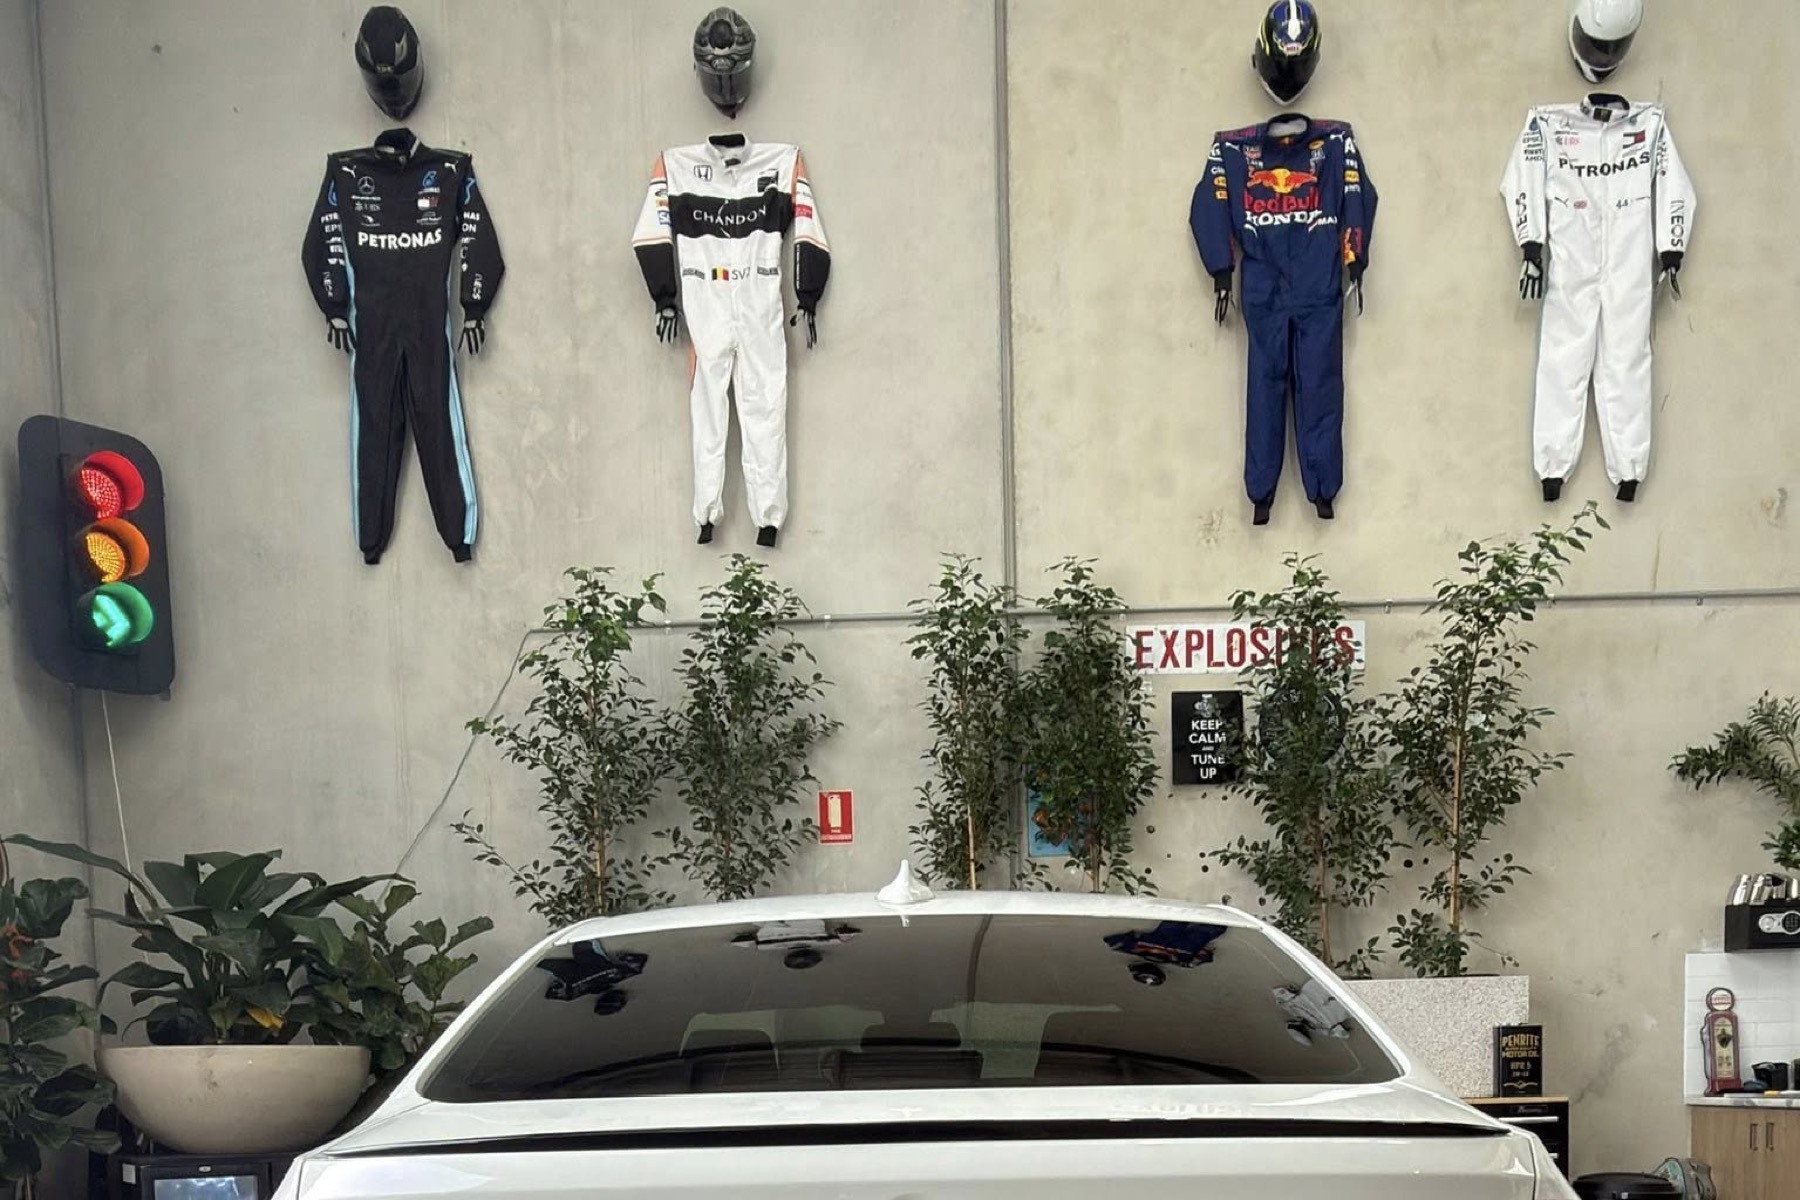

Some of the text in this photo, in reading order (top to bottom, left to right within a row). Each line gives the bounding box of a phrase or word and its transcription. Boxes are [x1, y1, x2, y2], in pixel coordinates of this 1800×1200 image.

[693, 205, 766, 225] CHANDON
[357, 228, 442, 250] PETRONAS
[1135, 626, 1356, 669] EXPLOSIES
[1188, 732, 1227, 744] CALM
[1190, 753, 1225, 765] TUNE
[1200, 767, 1217, 779] UP
[1502, 1033, 1540, 1047] PENRITE
